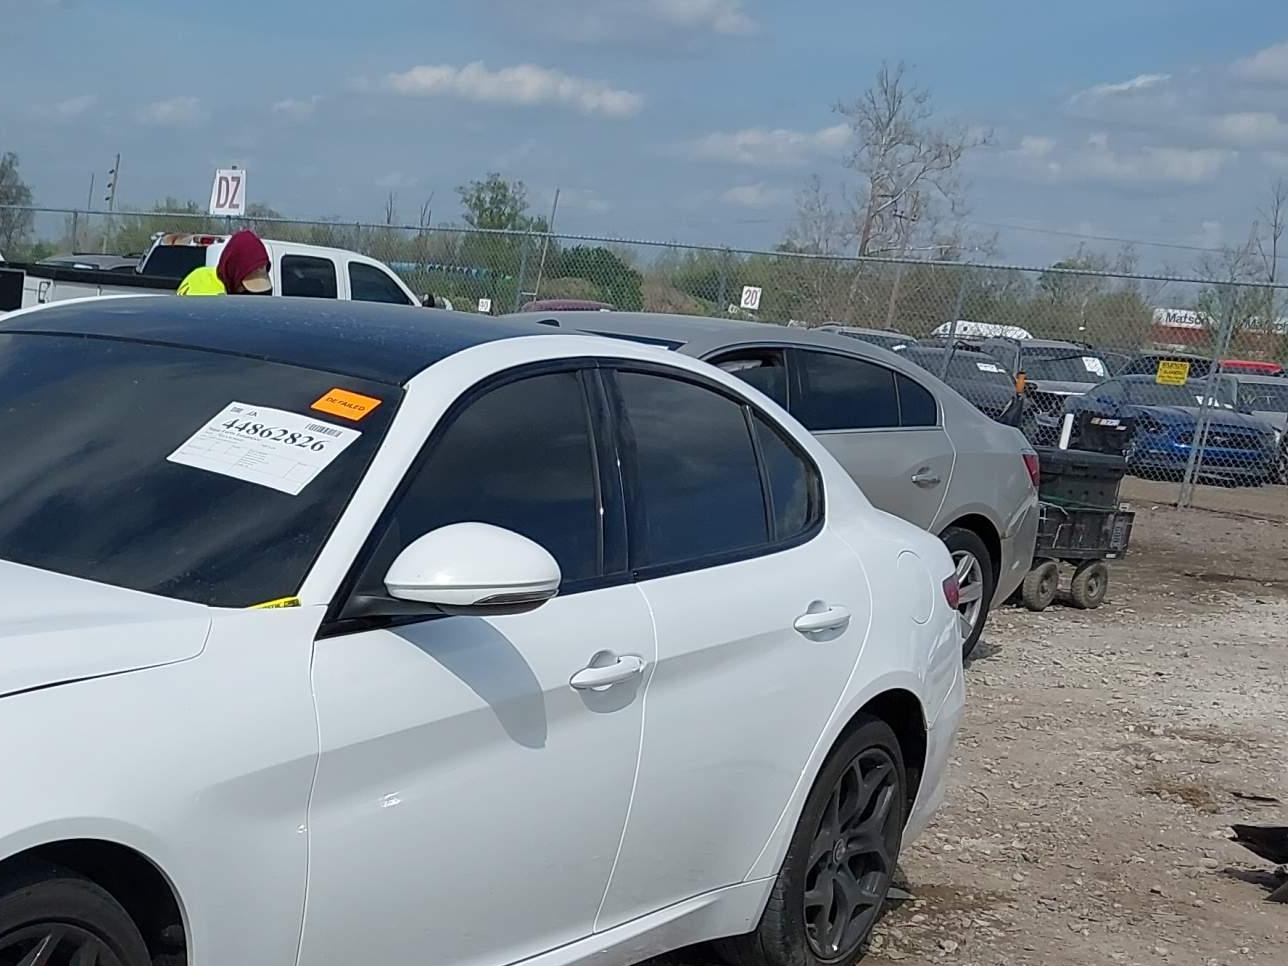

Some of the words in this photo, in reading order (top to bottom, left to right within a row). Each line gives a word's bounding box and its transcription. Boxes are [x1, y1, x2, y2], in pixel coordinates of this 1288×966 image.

[215, 176, 241, 209] DZ
[744, 289, 758, 307] 20
[325, 396, 366, 412] DETAILED
[221, 418, 329, 452] 44862826
